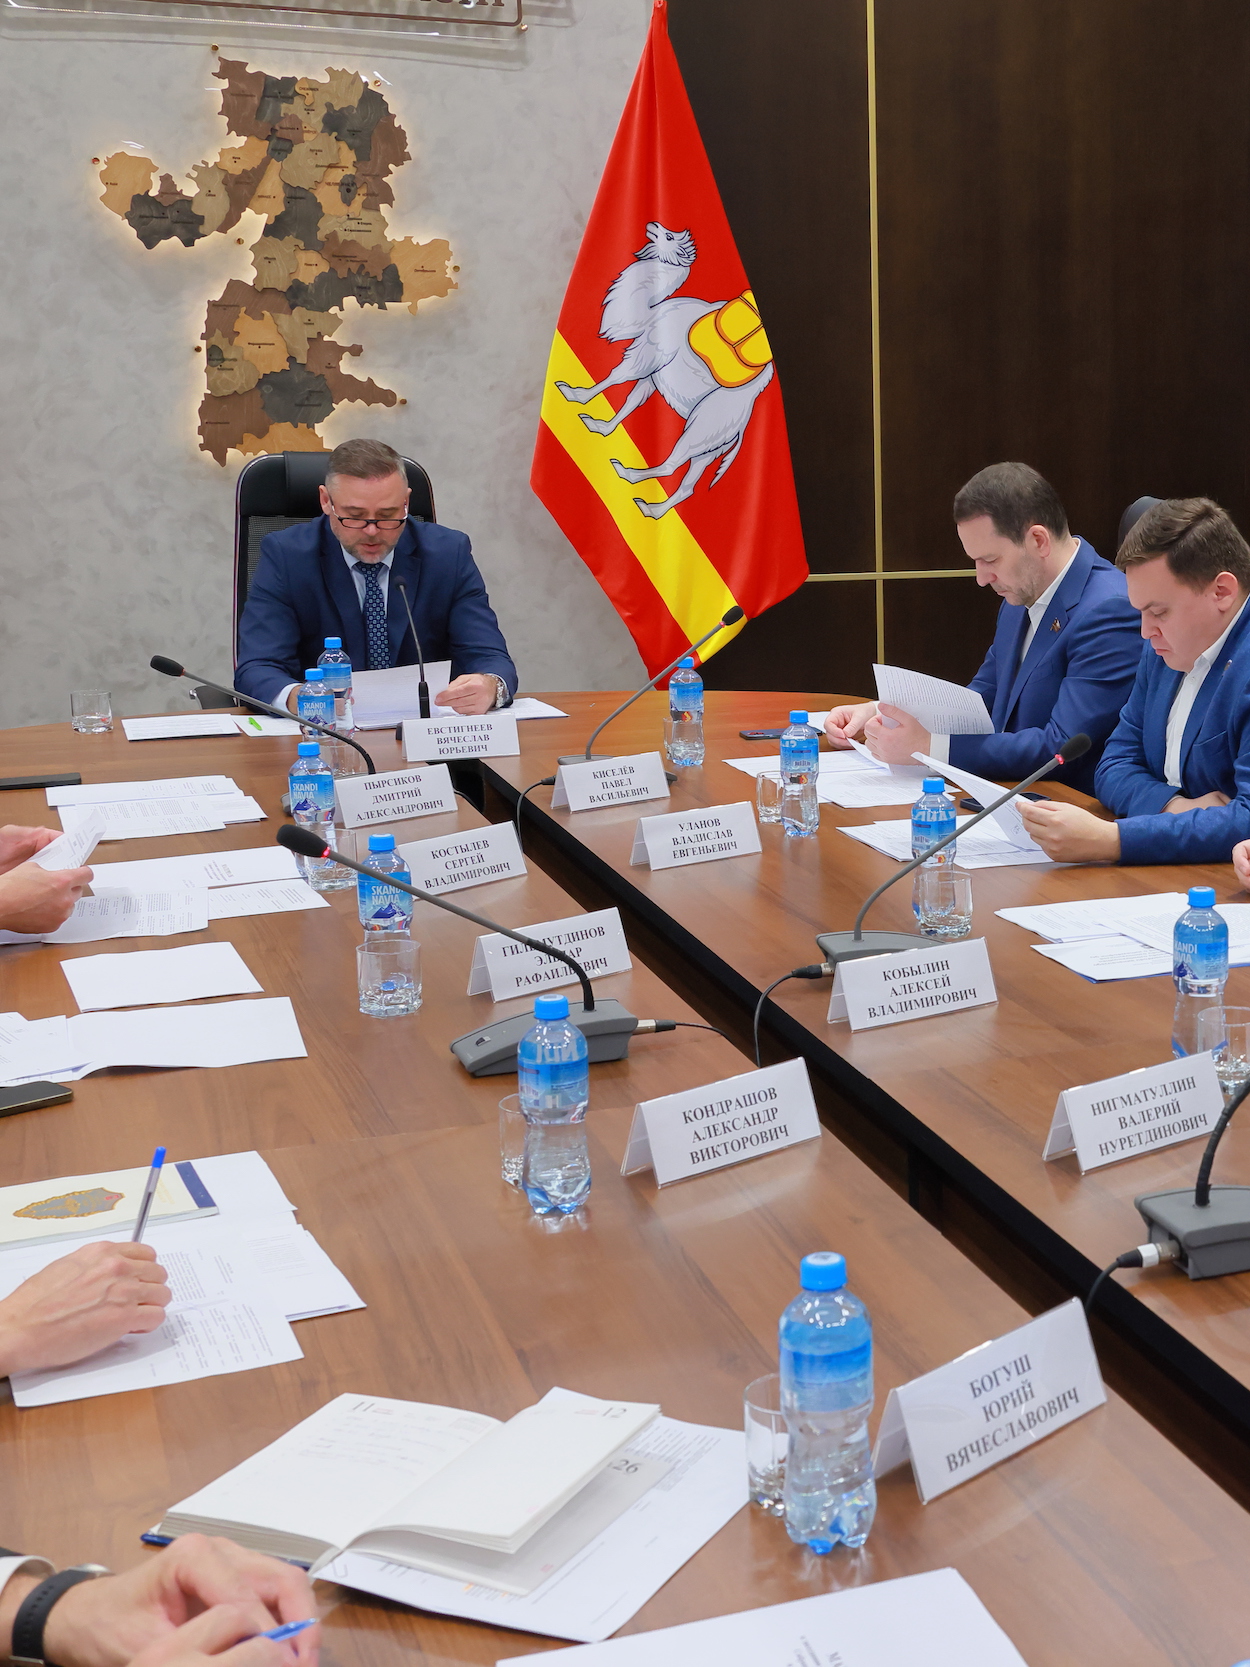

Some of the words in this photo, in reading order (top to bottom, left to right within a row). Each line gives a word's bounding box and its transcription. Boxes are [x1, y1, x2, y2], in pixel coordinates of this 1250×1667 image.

[427, 723, 493, 735] ЕВСТИГНЕЕВ
[436, 734, 490, 745] ВЯЧЕСЛАВ
[438, 744, 488, 755] ЮРЬЕВИЧ
[363, 775, 422, 790] ПЫРСИКОВ
[592, 765, 635, 779] КИСЕЛЁВ
[292, 783, 318, 792] SKANDI
[601, 778, 632, 790] ПАВЕЛ
[372, 787, 422, 804] ДМИТРИЙ
[588, 787, 649, 803] ВАСИЛЬЕВИЧ
[356, 800, 444, 821] АЛЕКСАНДРОВИЧ
[678, 818, 721, 832] УЛАНОВ
[671, 829, 733, 846] ВЛАДИСЛАВ
[430, 839, 490, 860] КОСТЫЛЕВ
[672, 841, 738, 859] ЕВГЕНЬЕВИЧ
[444, 852, 485, 870] СЕРГЕЙ
[424, 862, 511, 889] ВЛАДИМИРОВИЧ
[371, 885, 404, 896] SKAND
[371, 894, 400, 905] NAVIA
[501, 926, 605, 957] ГИЛУТДИНОВ
[534, 946, 583, 967] ЭЛЬАР
[515, 957, 608, 988] РАФАИЛЬВИЧ
[882, 959, 951, 982] КОБЫЛИН
[889, 974, 952, 998] АЛЕКСЕЙ
[867, 988, 978, 1018] ВЛАДИМИРОВИЧ
[682, 1087, 778, 1125] КОНДРАШОВ
[1090, 1076, 1197, 1116] НИГМАТУЛЛИН
[1118, 1098, 1182, 1130] ВАЛЕРИЙ
[692, 1107, 779, 1143] АЛЕКСАНДР
[1098, 1113, 1208, 1157] НУРЕТДИНОВИЧ
[689, 1124, 790, 1165] ВИКТОРОВИЧ
[969, 1354, 1032, 1400] БОГУШ
[982, 1379, 1036, 1423] ЮРИЙ
[602, 1407, 627, 1419] 12
[945, 1386, 1080, 1473] ВЯЧЕСЛАВОВИЧ
[612, 1458, 642, 1475] 26
